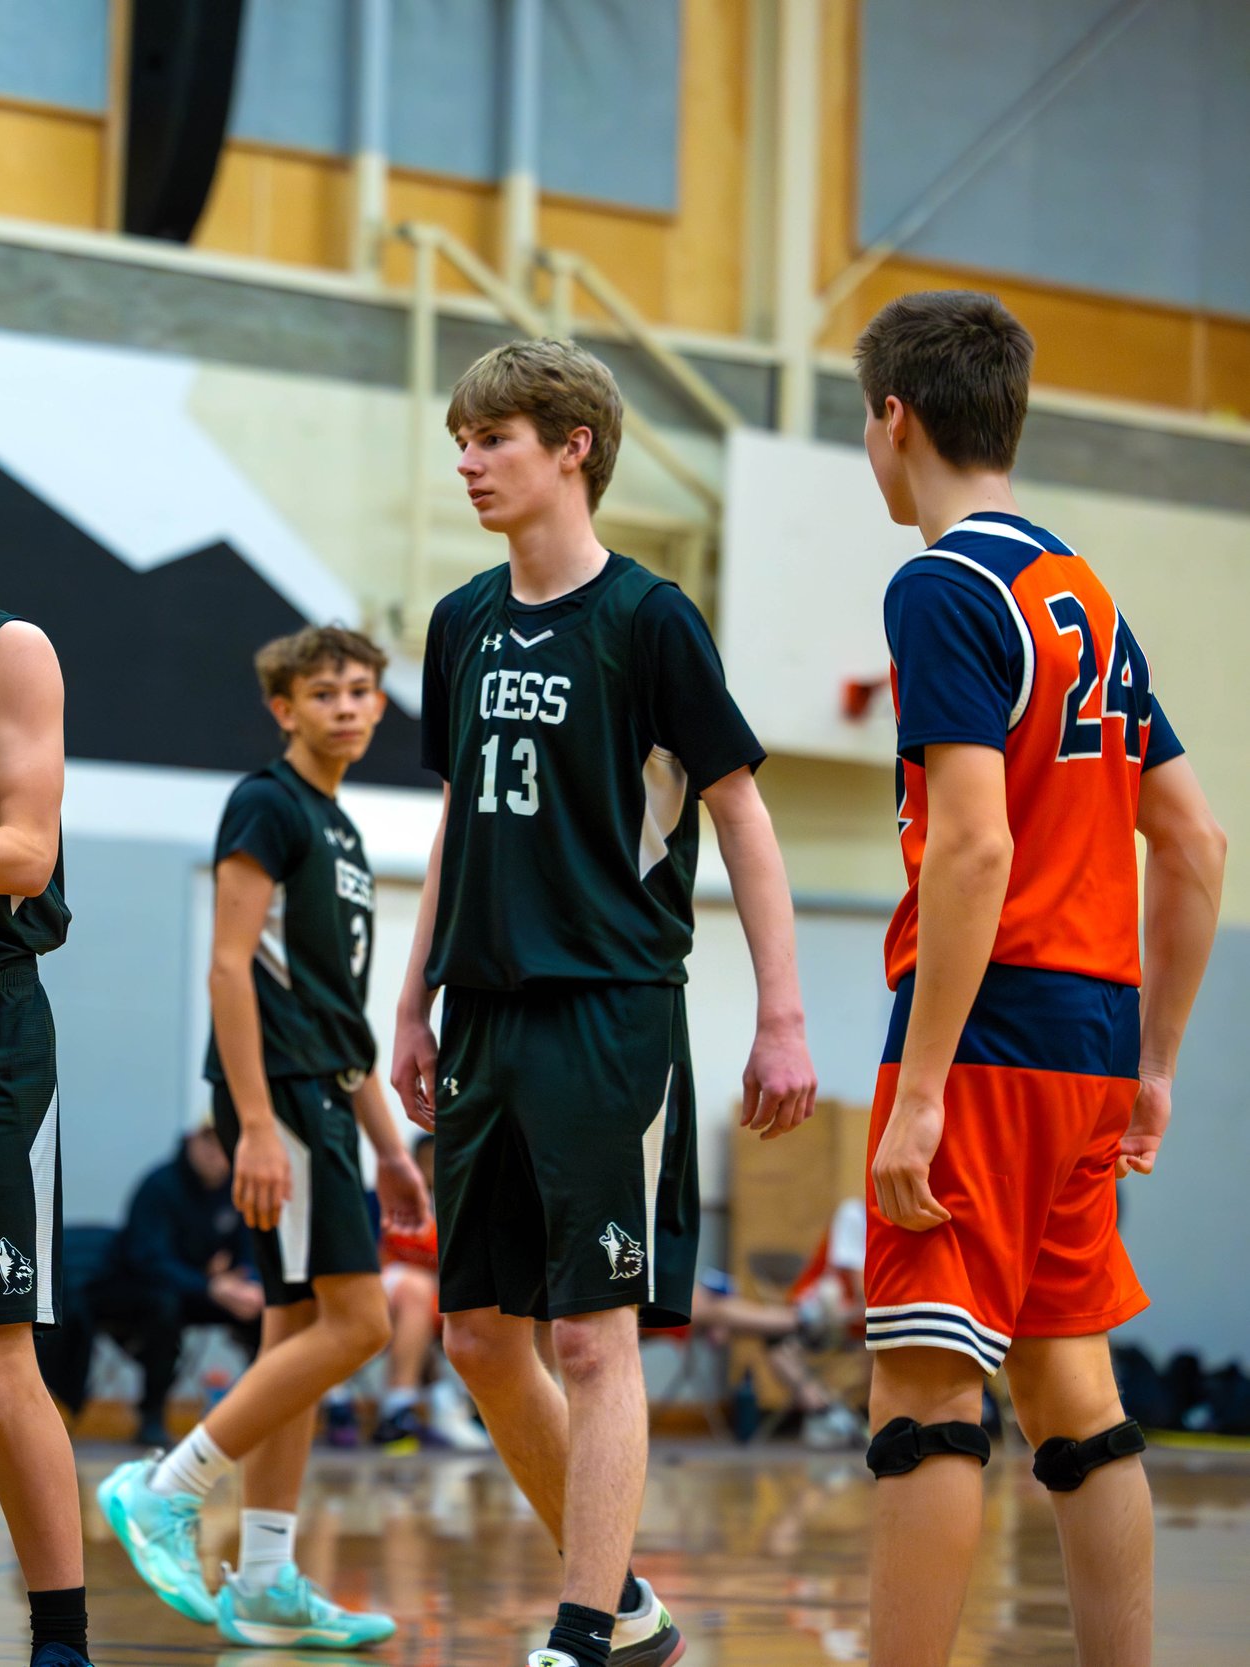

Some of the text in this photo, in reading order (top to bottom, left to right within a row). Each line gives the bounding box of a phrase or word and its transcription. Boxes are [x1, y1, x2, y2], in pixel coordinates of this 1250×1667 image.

[479, 669, 572, 725] GESS
[1044, 590, 1152, 764] 24
[478, 734, 540, 816] 13
[350, 914, 369, 978] 3
